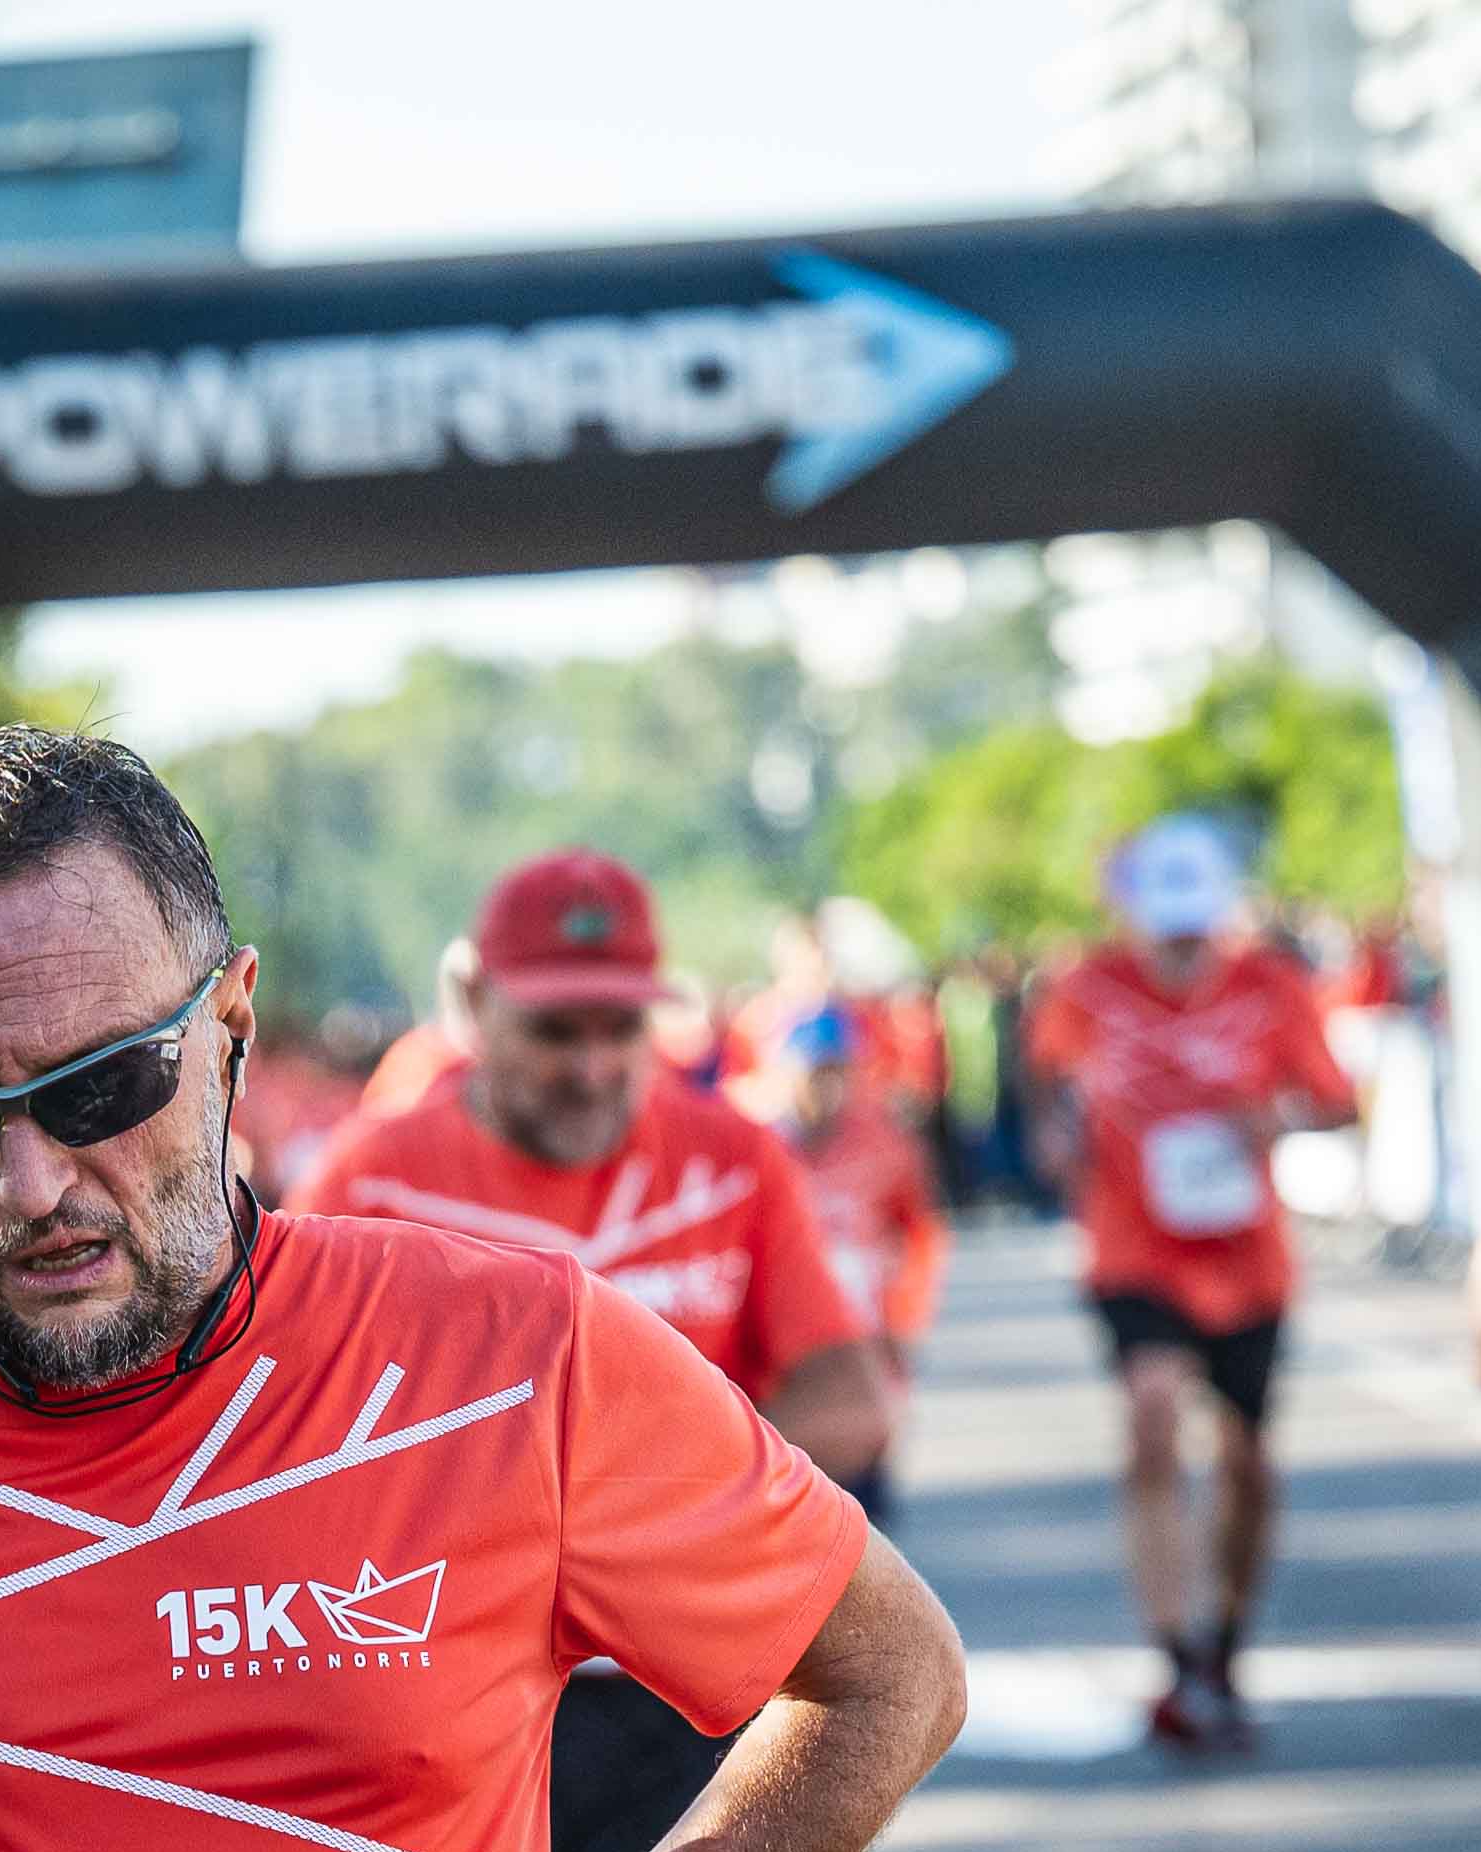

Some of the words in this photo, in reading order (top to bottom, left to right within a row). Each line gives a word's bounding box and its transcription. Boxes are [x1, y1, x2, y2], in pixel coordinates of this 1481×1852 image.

[156, 1583, 306, 1659] 15K
[172, 1654, 314, 1681] PUERTO
[327, 1650, 433, 1674] NORTE
